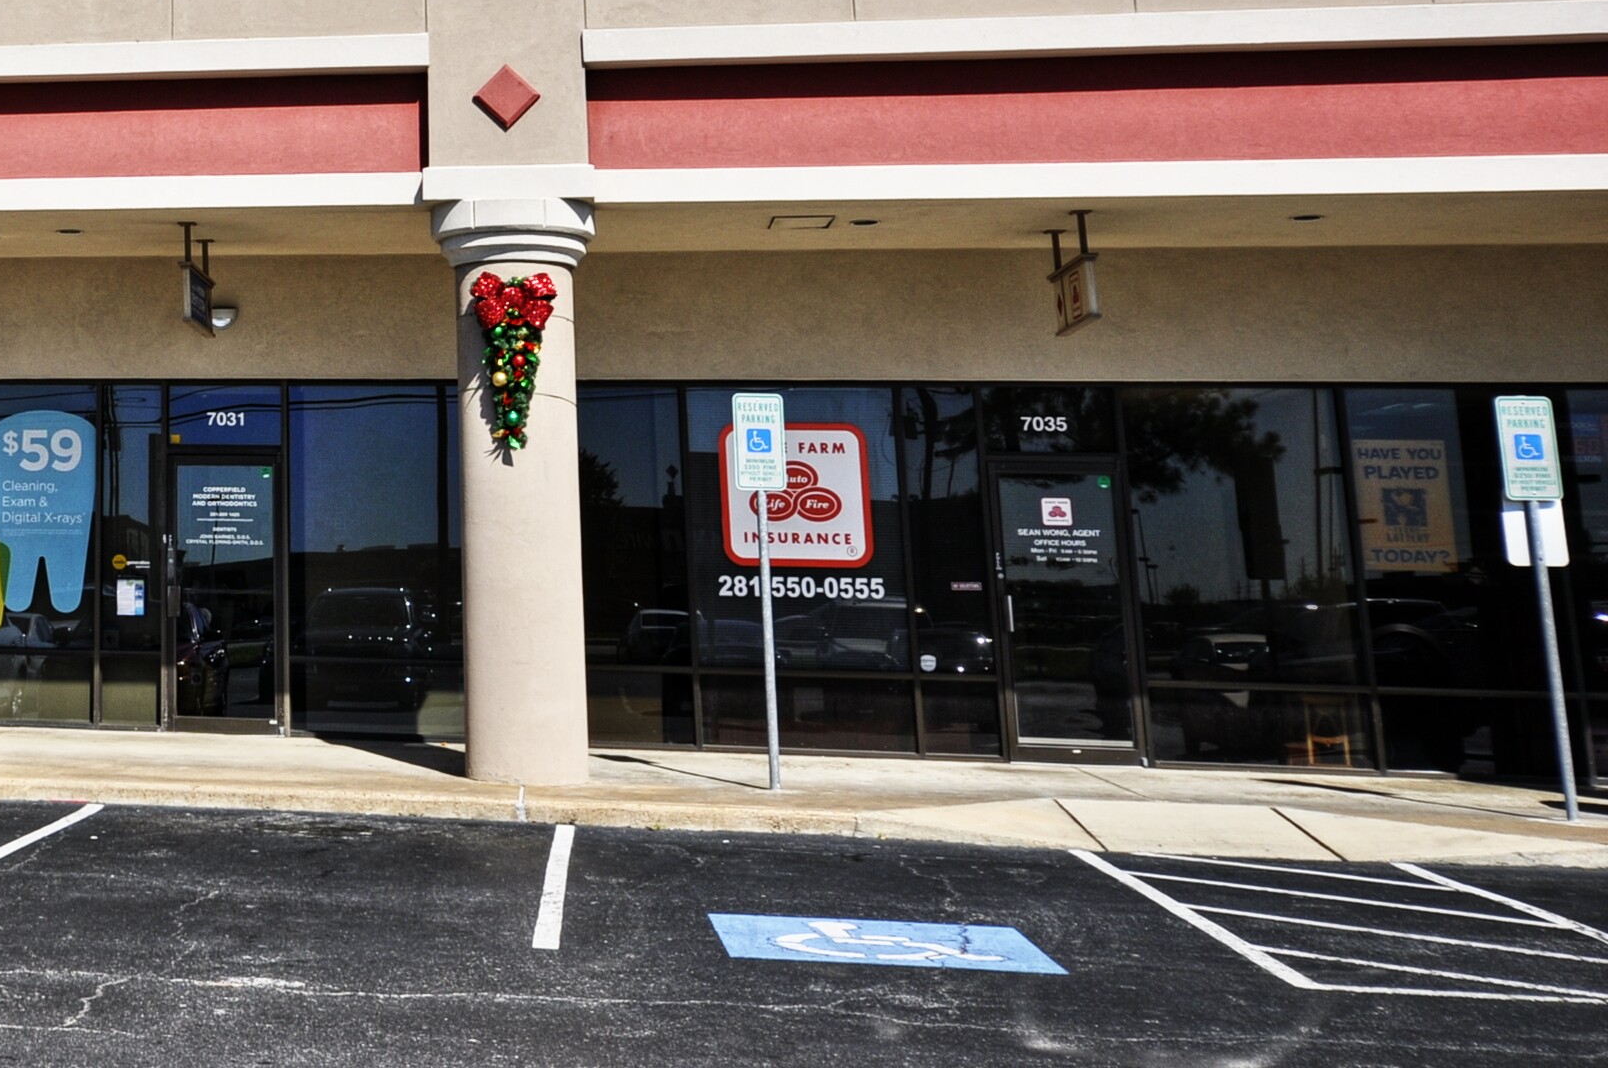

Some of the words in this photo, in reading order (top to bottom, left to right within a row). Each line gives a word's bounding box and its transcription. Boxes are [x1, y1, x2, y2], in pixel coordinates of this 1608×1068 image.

[737, 402, 779, 412] RESERVED
[1500, 405, 1548, 416] RESERVED
[206, 412, 245, 426] 7031
[741, 414, 776, 424] PARKING
[1020, 416, 1068, 432] 7035
[1507, 419, 1545, 428] PARKING
[2, 428, 83, 472] $59
[798, 442, 846, 454] FARM
[1357, 448, 1400, 460] HAVE
[1406, 448, 1441, 460] YOU
[1363, 465, 1439, 479] PLAYED
[786, 475, 809, 483] uto
[2, 480, 58, 493] Cleaning,
[2, 496, 36, 507] Exam
[39, 496, 48, 507] &
[805, 499, 830, 509] Fire
[2, 512, 40, 525] Digital
[744, 532, 852, 545] INSURANCE
[1072, 529, 1101, 537] AGENT
[1371, 549, 1451, 564] TODAY?
[772, 576, 885, 599] 550-0555
